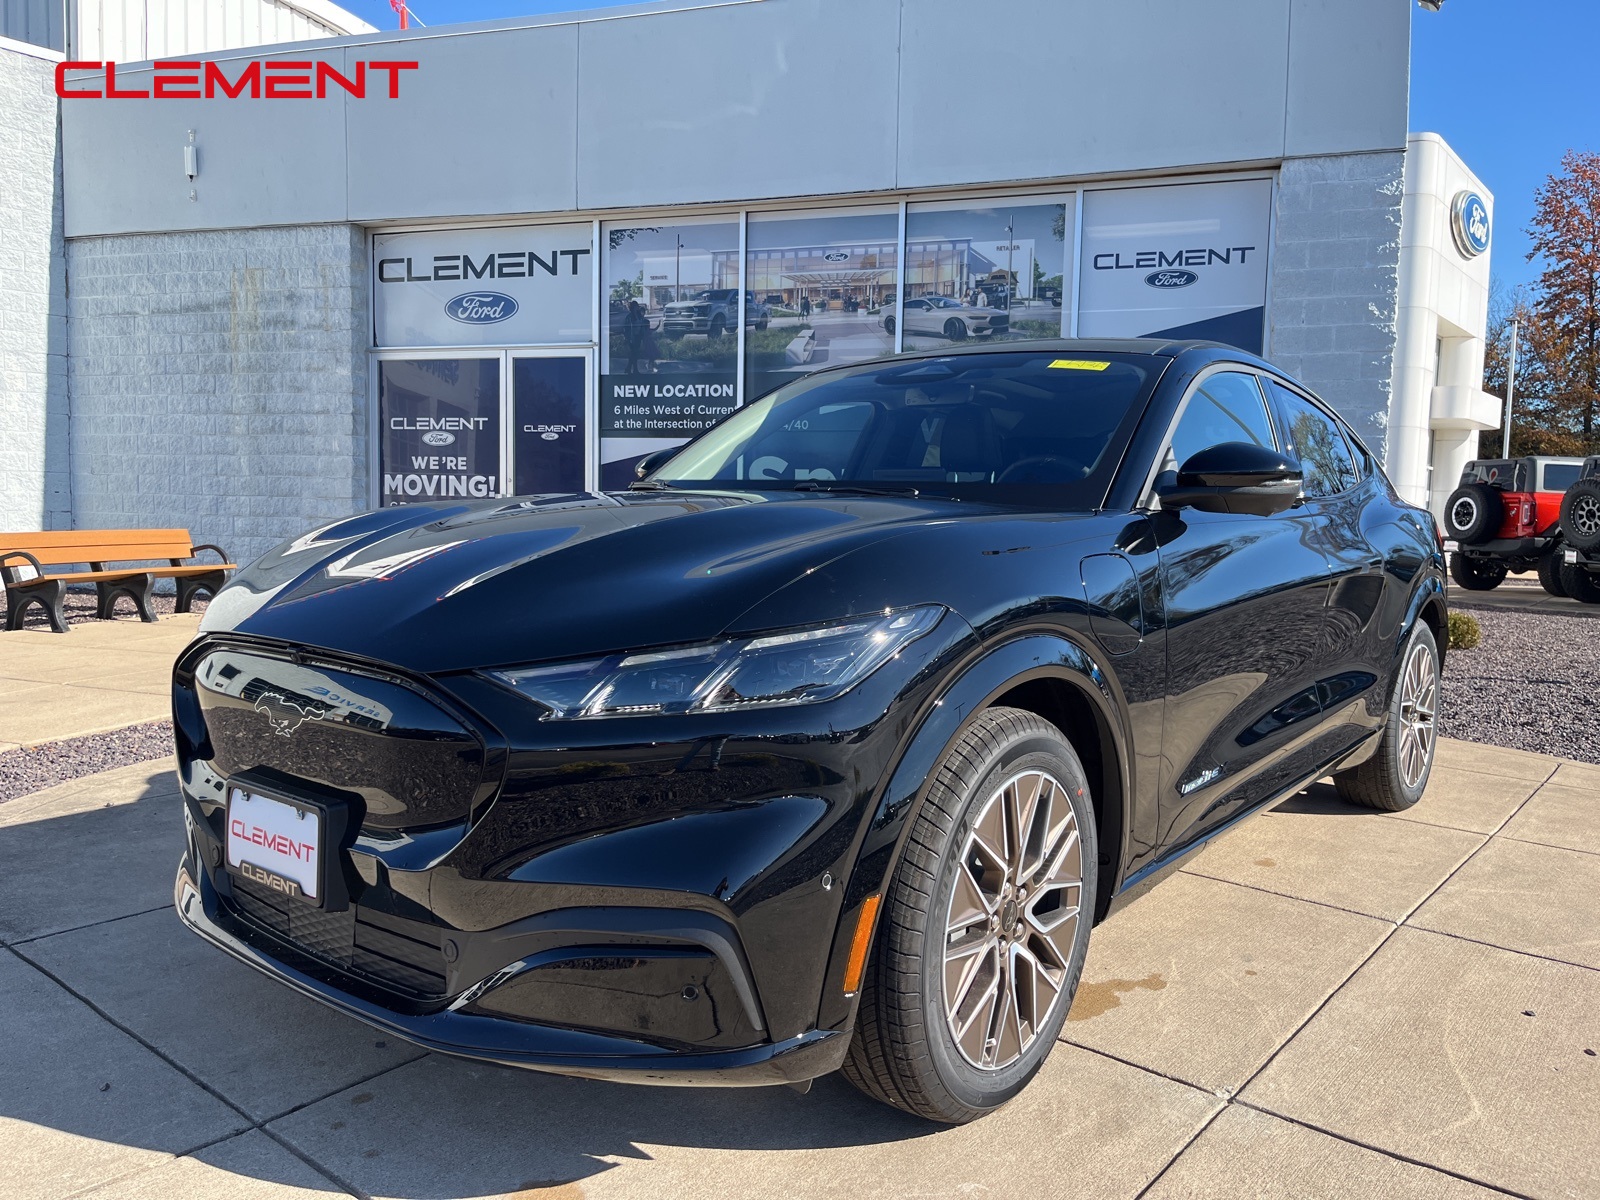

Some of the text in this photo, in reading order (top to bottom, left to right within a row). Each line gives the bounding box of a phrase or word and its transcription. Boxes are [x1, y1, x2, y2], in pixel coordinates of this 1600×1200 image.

[1468, 201, 1489, 246] Ford
[378, 248, 591, 283] CLEMENT
[1093, 246, 1256, 270] CLEMENT
[1153, 271, 1189, 287] Ford
[455, 294, 507, 321] Ford
[613, 384, 734, 398] NEW LOCATION
[613, 405, 621, 415] 6
[624, 405, 650, 415] Miles
[653, 404, 681, 415] West
[683, 404, 695, 415] of
[390, 417, 489, 430] CLEMENT
[523, 424, 577, 433] CLEMENT
[613, 419, 624, 429] at
[626, 419, 642, 429] the
[644, 419, 703, 429] Intersection
[427, 432, 450, 444] Ford
[411, 456, 467, 470] WE'RE
[384, 473, 496, 498] MOVING!
[231, 819, 315, 863] CLEMENT
[241, 862, 298, 896] CLEMENT
